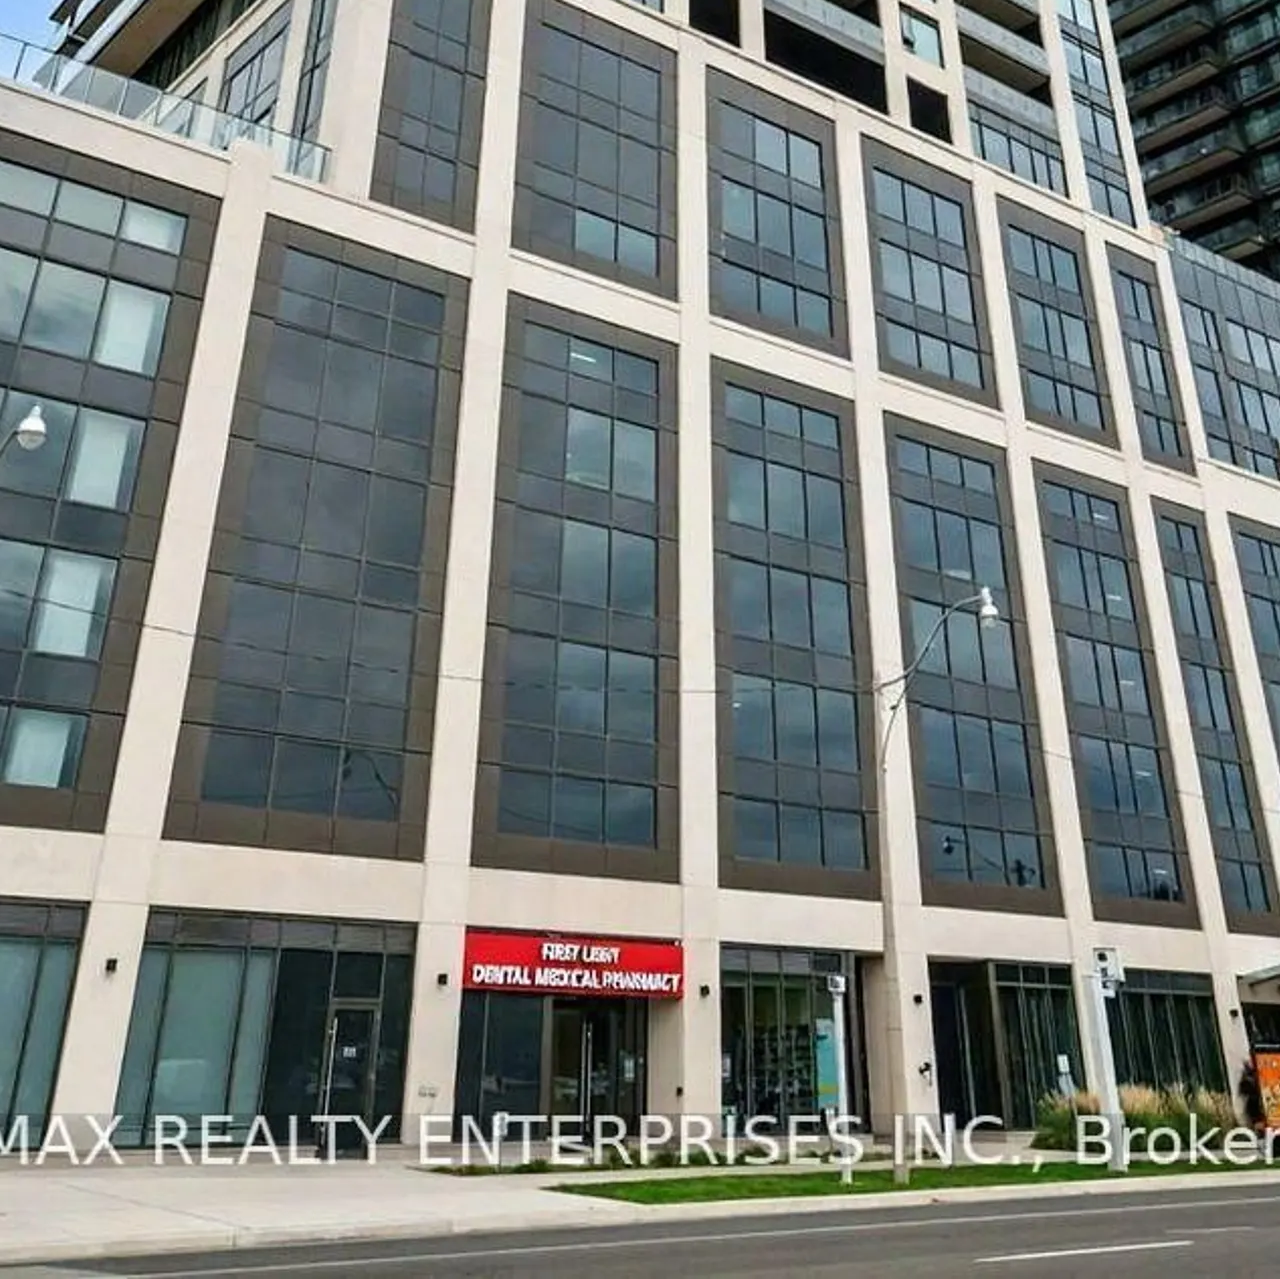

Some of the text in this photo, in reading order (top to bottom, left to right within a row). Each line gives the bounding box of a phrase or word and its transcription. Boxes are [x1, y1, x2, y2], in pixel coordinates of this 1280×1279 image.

[472, 964, 682, 993] DENTAL MEDICAL PHARMACY
